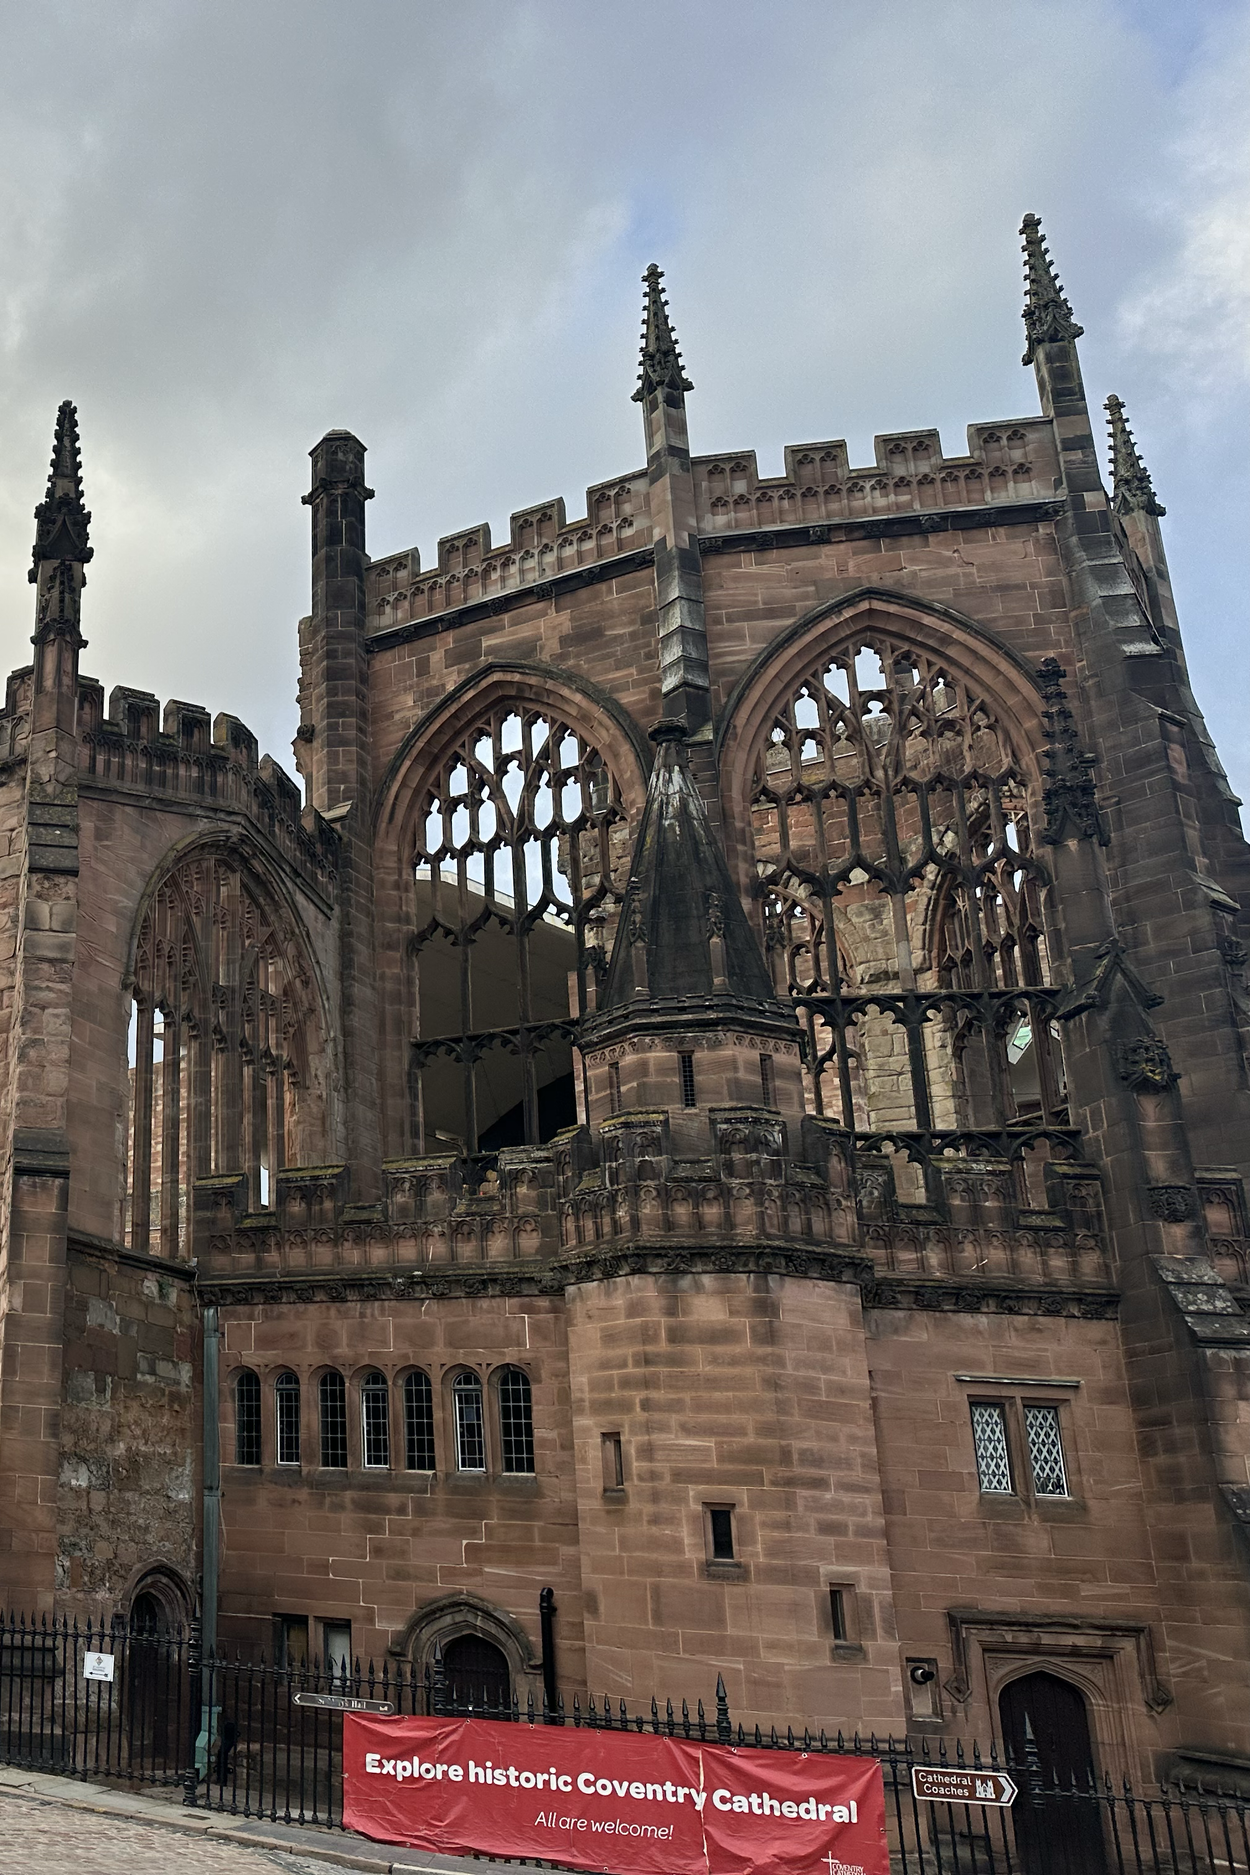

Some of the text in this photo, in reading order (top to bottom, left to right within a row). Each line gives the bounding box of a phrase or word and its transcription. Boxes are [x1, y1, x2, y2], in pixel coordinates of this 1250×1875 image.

[351, 1700, 366, 1709] Hall
[919, 1772, 972, 1785] Cathedral
[366, 1753, 857, 1824] Explore historic Coventry Cathedral
[924, 1784, 969, 1796] Coaches
[535, 1811, 673, 1840] All are welcome!
